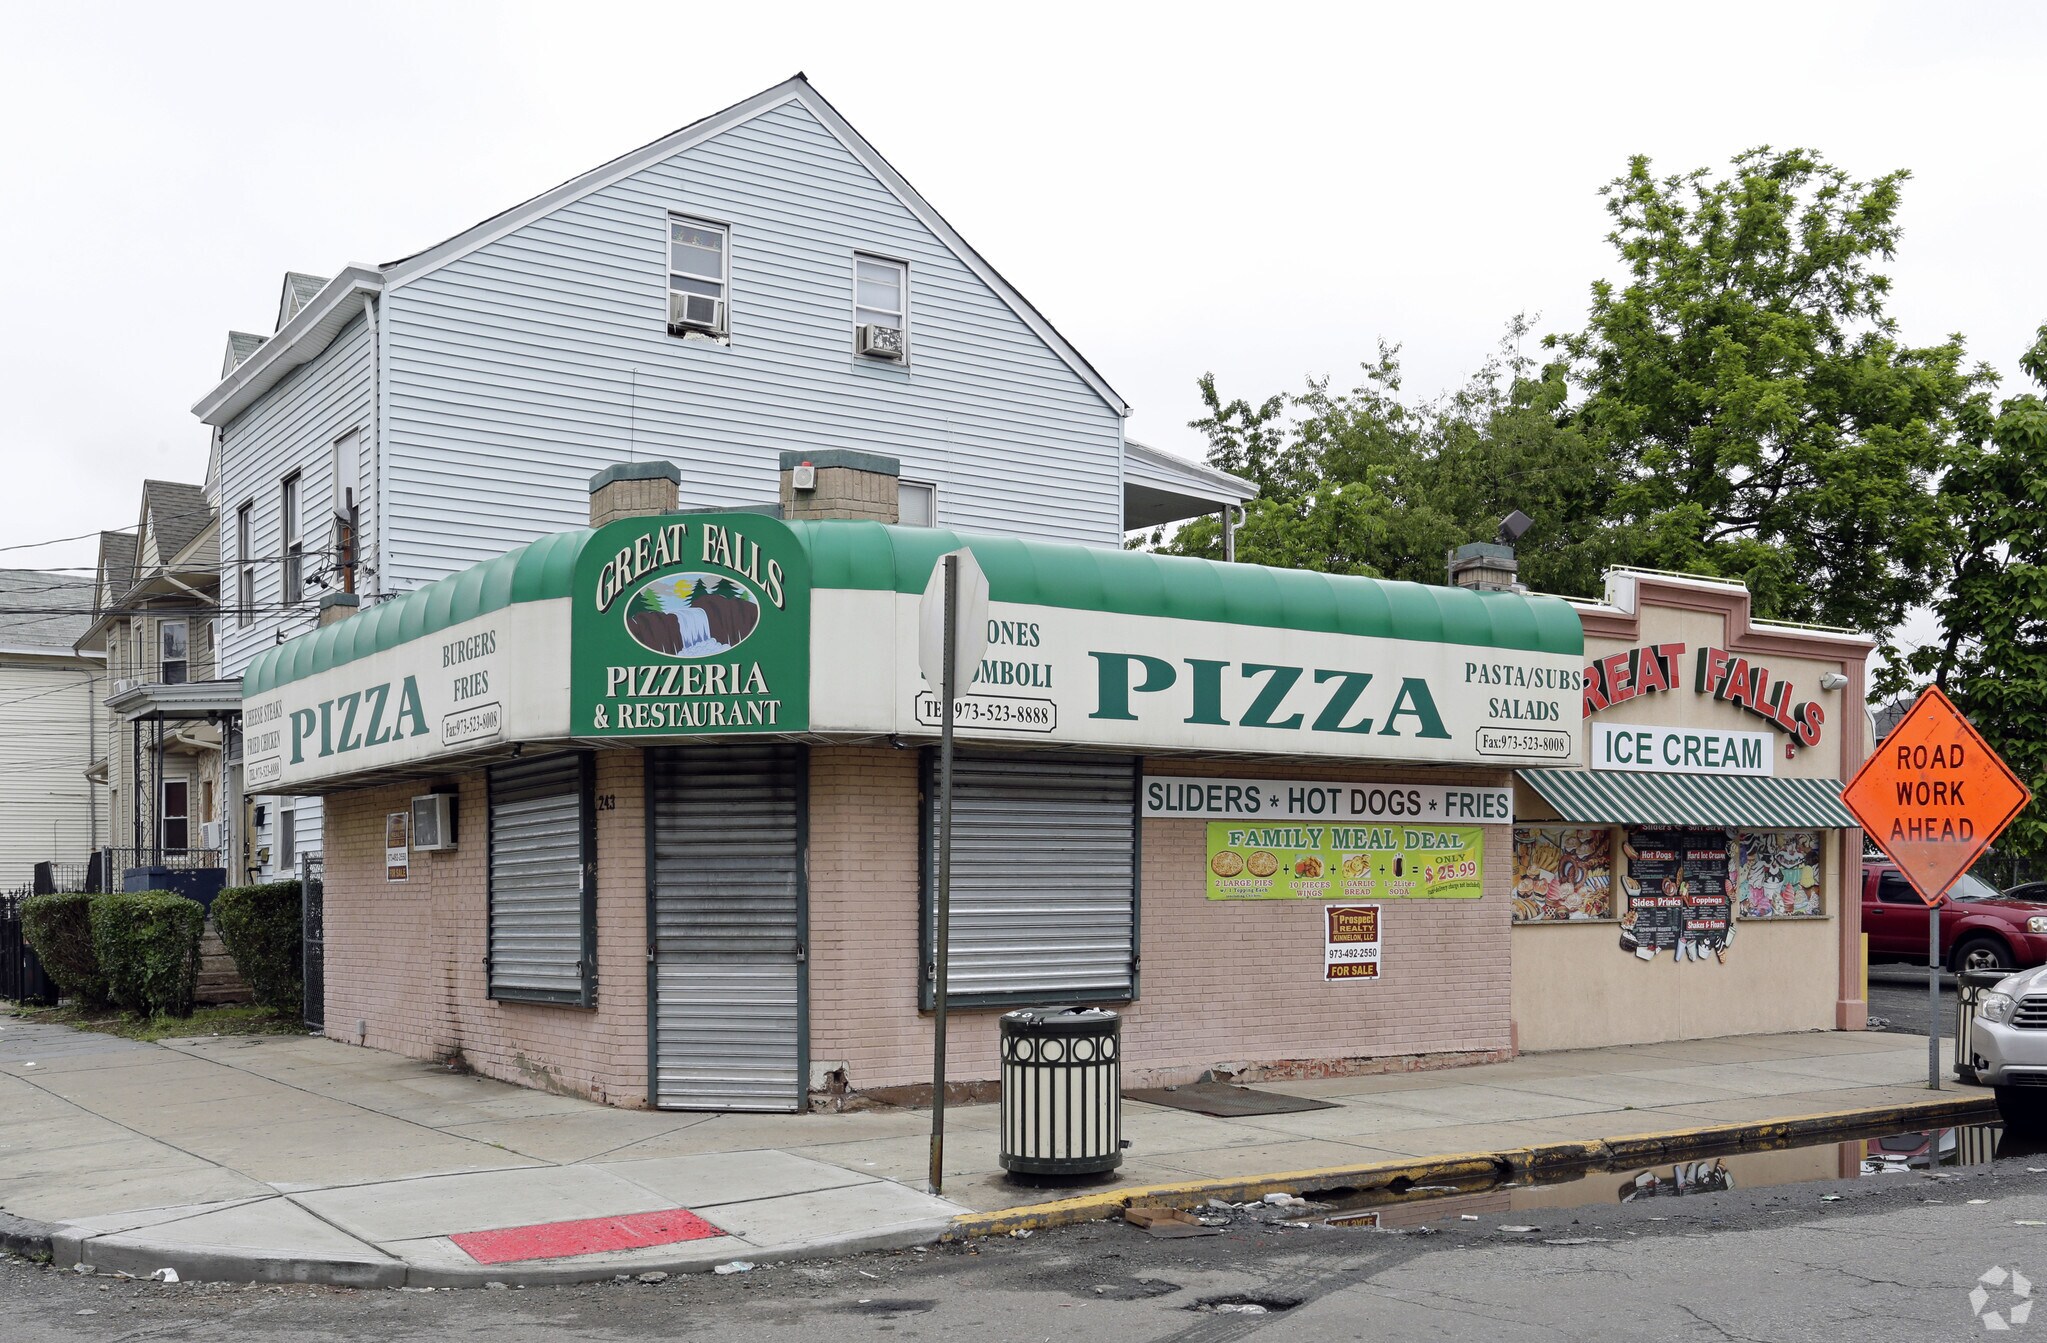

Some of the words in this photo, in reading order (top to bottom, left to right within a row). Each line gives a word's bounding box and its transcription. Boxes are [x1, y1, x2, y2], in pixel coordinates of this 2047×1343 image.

[596, 523, 688, 613] GREAT
[702, 523, 785, 611] FALLS
[442, 629, 496, 668] BURGERS
[453, 670, 489, 702] FRIES
[606, 661, 770, 698] PIZZERIA
[1465, 662, 1581, 690] PASTA/SUBS
[1088, 651, 1452, 740] PIZZA
[1582, 642, 1686, 720] REAT
[1696, 646, 1825, 747] FALLS
[246, 706, 263, 728] CHEESE
[264, 699, 283, 722] STEAKS
[289, 674, 430, 766] PIZZA
[594, 703, 610, 729] &
[617, 700, 781, 728] RESTAURANT
[1488, 697, 1560, 721] SALADS
[247, 736, 260, 756] FRIED
[261, 729, 281, 752] CHICKEN
[1482, 734, 1565, 751] Fax:973-523-8008
[1606, 730, 1653, 765] ICE
[1662, 733, 1762, 769] CREAM
[1897, 744, 1965, 770] ROAD
[598, 794, 616, 811] 243
[1147, 782, 1262, 814] SLIDERS
[1288, 787, 1343, 814] HOT
[1350, 789, 1422, 816] DOGS
[1445, 792, 1509, 818] FRIES
[1896, 781, 1965, 806] WORK
[1229, 828, 1324, 849] FAMILY
[1331, 828, 1398, 850] MEAL
[1404, 830, 1464, 850] DEAL
[1890, 817, 1974, 842] AHEAD
[1435, 854, 1466, 865] ONLY
[1641, 850, 1654, 859] Hot
[1655, 850, 1672, 860] Dogs
[1437, 862, 1477, 880] 25.99
[1632, 898, 1655, 907] Sides
[1657, 897, 1681, 906] Drinks
[1691, 897, 1722, 906] Toppings
[1339, 912, 1375, 926] Prospect
[1329, 948, 1378, 959] 973-492-2550
[1331, 966, 1350, 976] FOR
[1351, 965, 1374, 975] SALE
